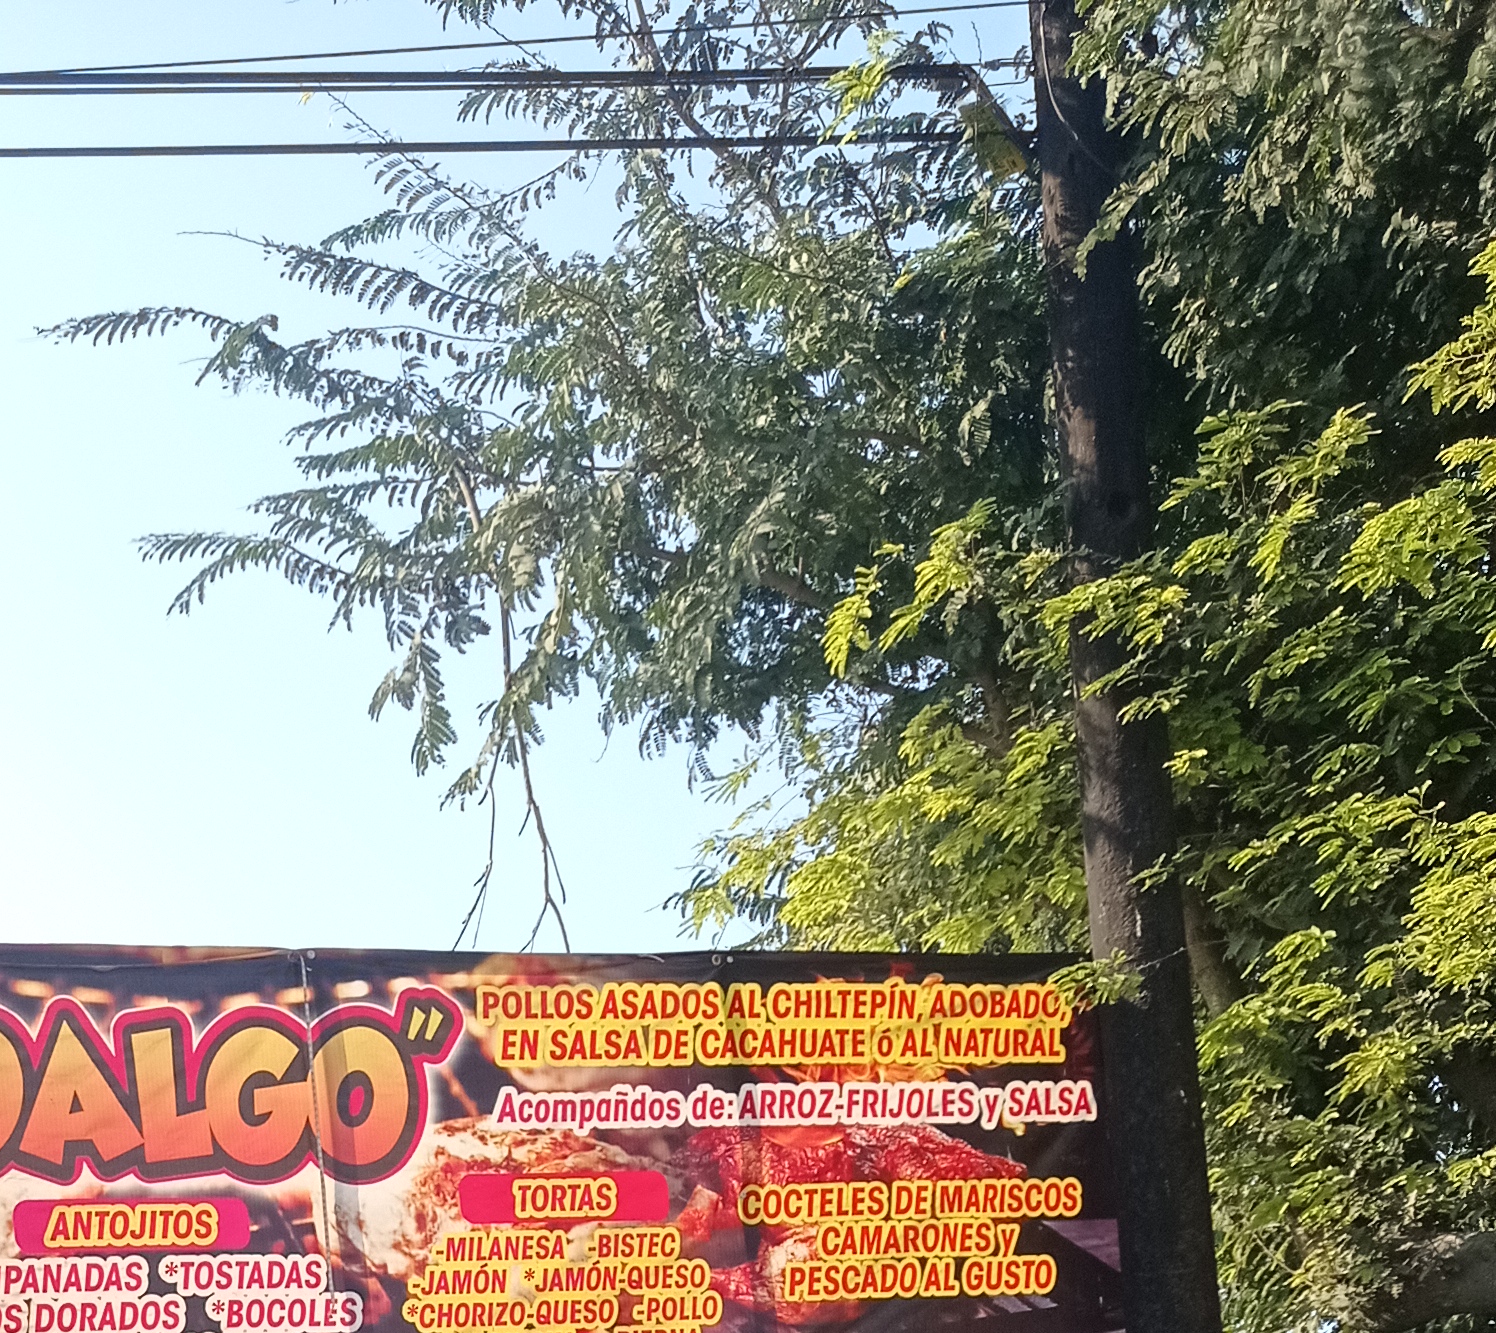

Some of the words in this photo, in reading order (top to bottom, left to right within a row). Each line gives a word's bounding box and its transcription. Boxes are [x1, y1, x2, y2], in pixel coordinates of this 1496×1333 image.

[482, 988, 595, 1020] POLLOS
[599, 988, 720, 1020] ASADOS
[727, 989, 761, 1019] AL
[772, 981, 923, 1023] CHILTEPÍN,
[929, 989, 1067, 1023] ADOBADO,
[500, 1029, 540, 1061] EN
[549, 1029, 642, 1060] SALSA
[653, 1029, 689, 1060] DE
[699, 1028, 866, 1059] CACAHUATE
[903, 1027, 937, 1058] AL
[944, 1027, 1061, 1058] NATURAL
[497, 1090, 681, 1129] Acompañdos
[691, 1090, 734, 1121] de:
[738, 1087, 975, 1120] ARROZ-FRIJOLES
[985, 1094, 1000, 1123] y
[1008, 1086, 1093, 1117] SALSA
[517, 1182, 613, 1213] TORTAS
[741, 1184, 886, 1220] COCTELES
[895, 1184, 928, 1216] DE
[939, 1181, 1079, 1215] MARISCOS
[49, 1208, 213, 1243] ANTOJITOS
[820, 1222, 992, 1257] CAMARONES
[1000, 1227, 1016, 1258] y
[788, 1262, 918, 1297] PESCADO
[923, 1261, 956, 1292] AL
[966, 1259, 1053, 1291] GUSTO
[34, 1299, 181, 1332] DORADOS
